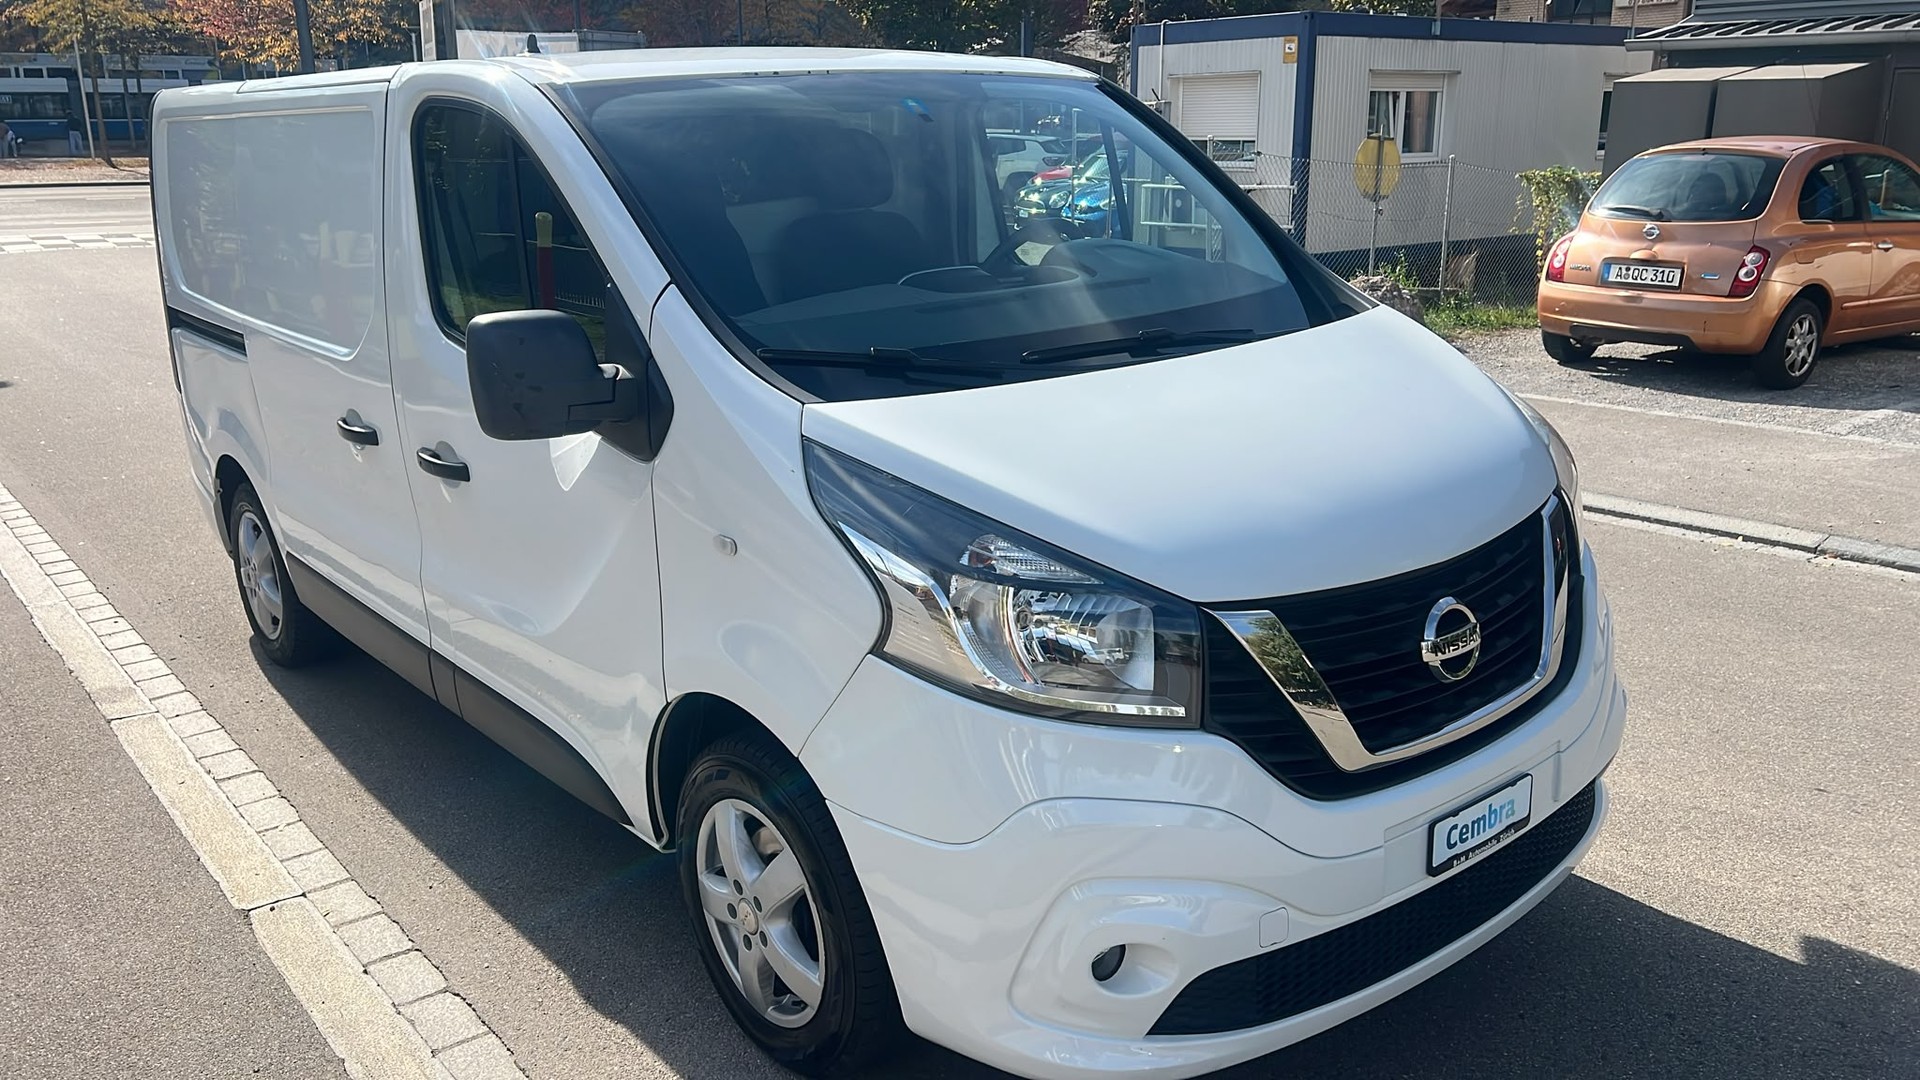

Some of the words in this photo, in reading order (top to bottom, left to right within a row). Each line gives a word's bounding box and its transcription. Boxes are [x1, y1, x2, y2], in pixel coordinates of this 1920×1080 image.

[1615, 266, 1623, 280] A
[1631, 267, 1648, 281] QC
[1650, 269, 1675, 283] 310
[1446, 798, 1516, 850] Cembra
